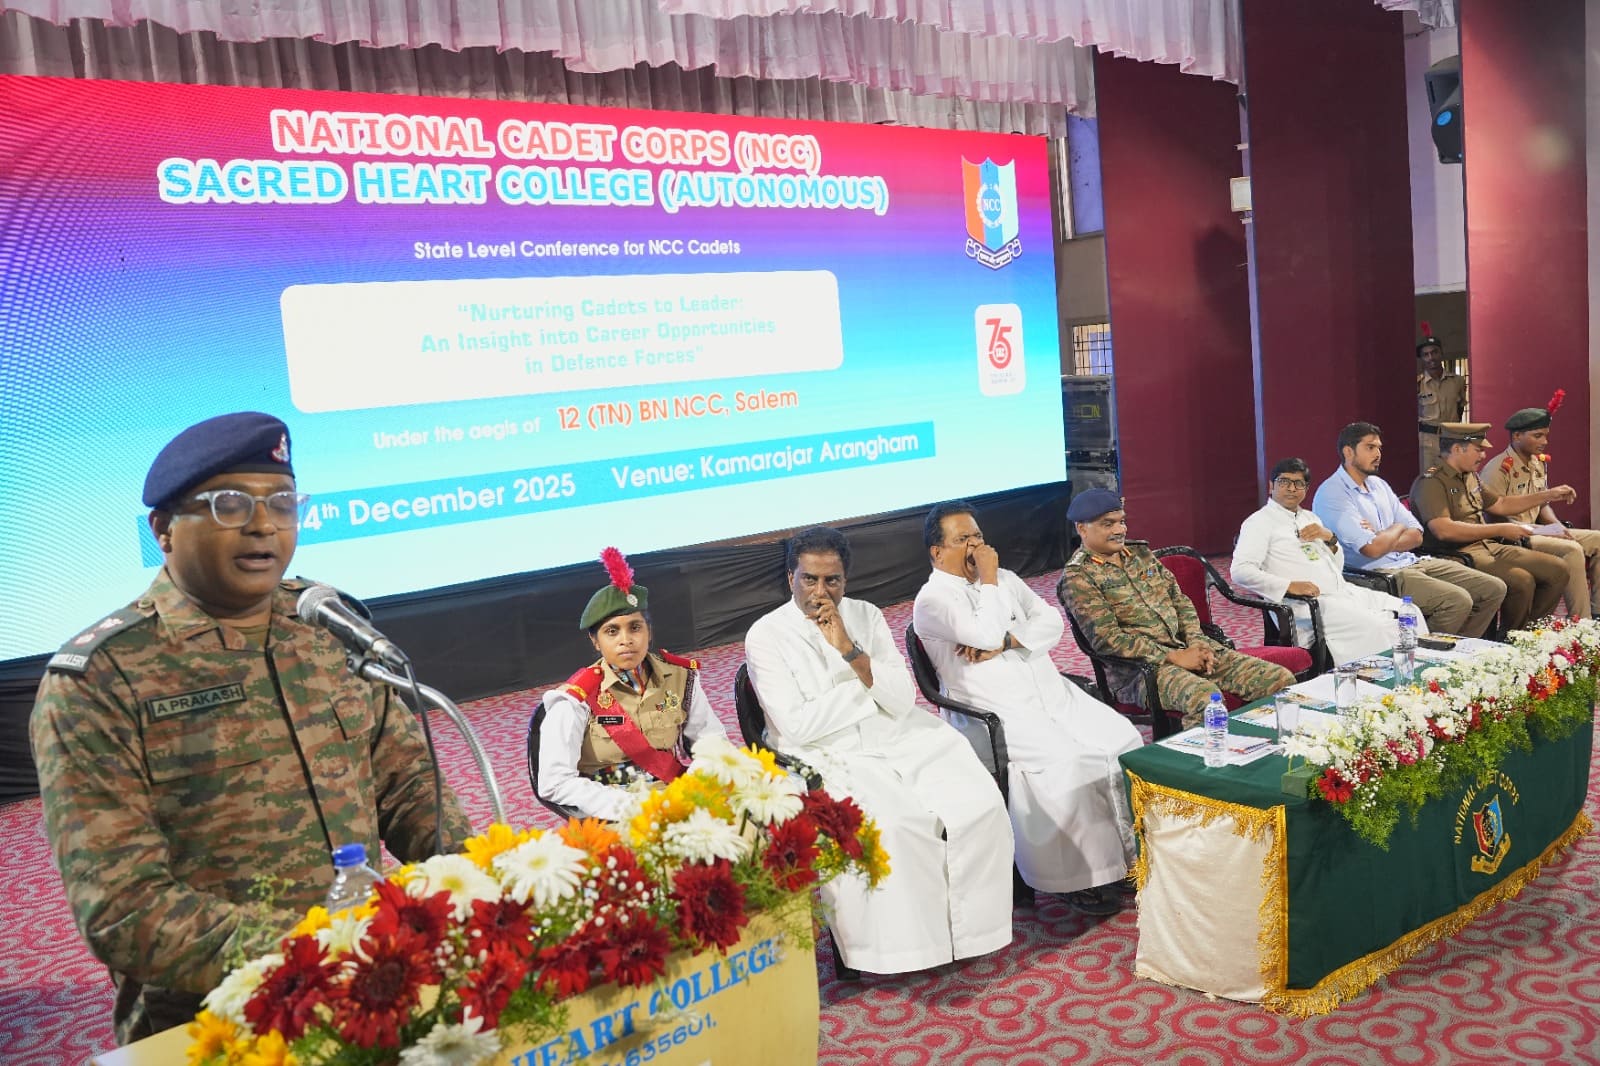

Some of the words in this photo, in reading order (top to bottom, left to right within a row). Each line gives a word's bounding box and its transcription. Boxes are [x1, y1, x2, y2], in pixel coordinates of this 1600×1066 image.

[271, 110, 495, 156] NATIONAL
[498, 119, 615, 163] CADET
[621, 125, 730, 167] CORPS
[733, 132, 821, 176] (NCC)
[158, 158, 347, 204] SACRED
[354, 163, 491, 205] HEART
[496, 166, 654, 206] COLLEGE
[657, 172, 889, 215] (AUTONOMOUS)
[983, 198, 1001, 212] NCC
[414, 241, 463, 259] State
[468, 241, 515, 258] Level
[521, 240, 618, 258] Conference
[623, 240, 645, 256] for
[649, 240, 686, 256] NCC
[688, 239, 741, 256] Cadets
[581, 298, 648, 317] Cadets
[654, 297, 673, 313] to
[680, 295, 743, 312] Leader:
[421, 334, 450, 353] An
[458, 329, 534, 353] Insight
[540, 328, 579, 346] into
[586, 325, 650, 343] Career
[657, 318, 776, 342] Opportunities
[985, 317, 1013, 370] 75
[524, 357, 543, 374] in
[551, 353, 628, 372] Defence
[373, 427, 429, 449] Under
[434, 423, 464, 443] the
[469, 419, 518, 441] aegis
[522, 417, 541, 434] of
[557, 407, 581, 430] 12
[587, 403, 632, 431] (TN)
[639, 398, 668, 423] BN
[674, 393, 731, 418] NCC,
[735, 388, 799, 411] Salem
[348, 485, 504, 526] December
[513, 473, 576, 505] 2025
[611, 464, 694, 489] Venue:
[700, 445, 813, 477] Kamarajar
[819, 431, 919, 462] Arangham
[156, 703, 168, 714] A
[170, 688, 242, 710] PRAKASH
